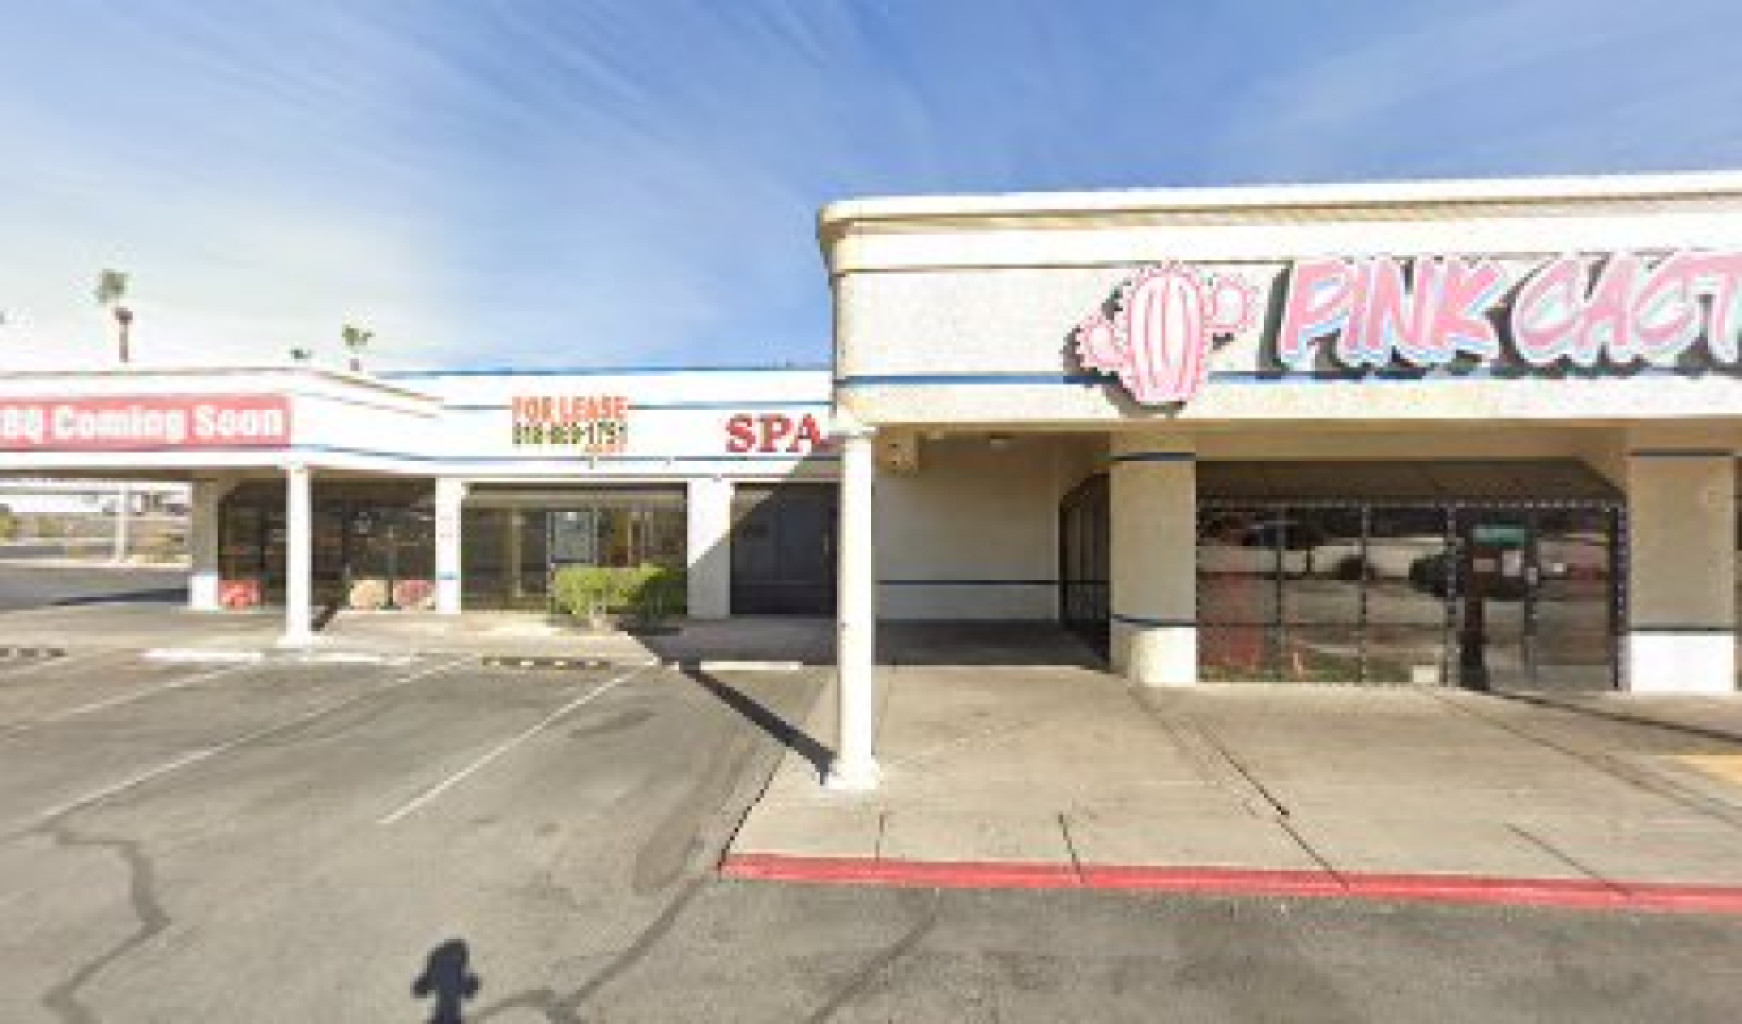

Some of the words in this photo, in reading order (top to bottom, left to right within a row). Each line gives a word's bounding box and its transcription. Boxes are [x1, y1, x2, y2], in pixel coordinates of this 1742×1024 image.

[1278, 256, 1504, 366] PINK
[52, 405, 187, 444] Coming
[193, 404, 284, 438] Soon
[512, 396, 554, 420] FOR
[560, 395, 628, 421] LEASE
[725, 413, 828, 454] SPA
